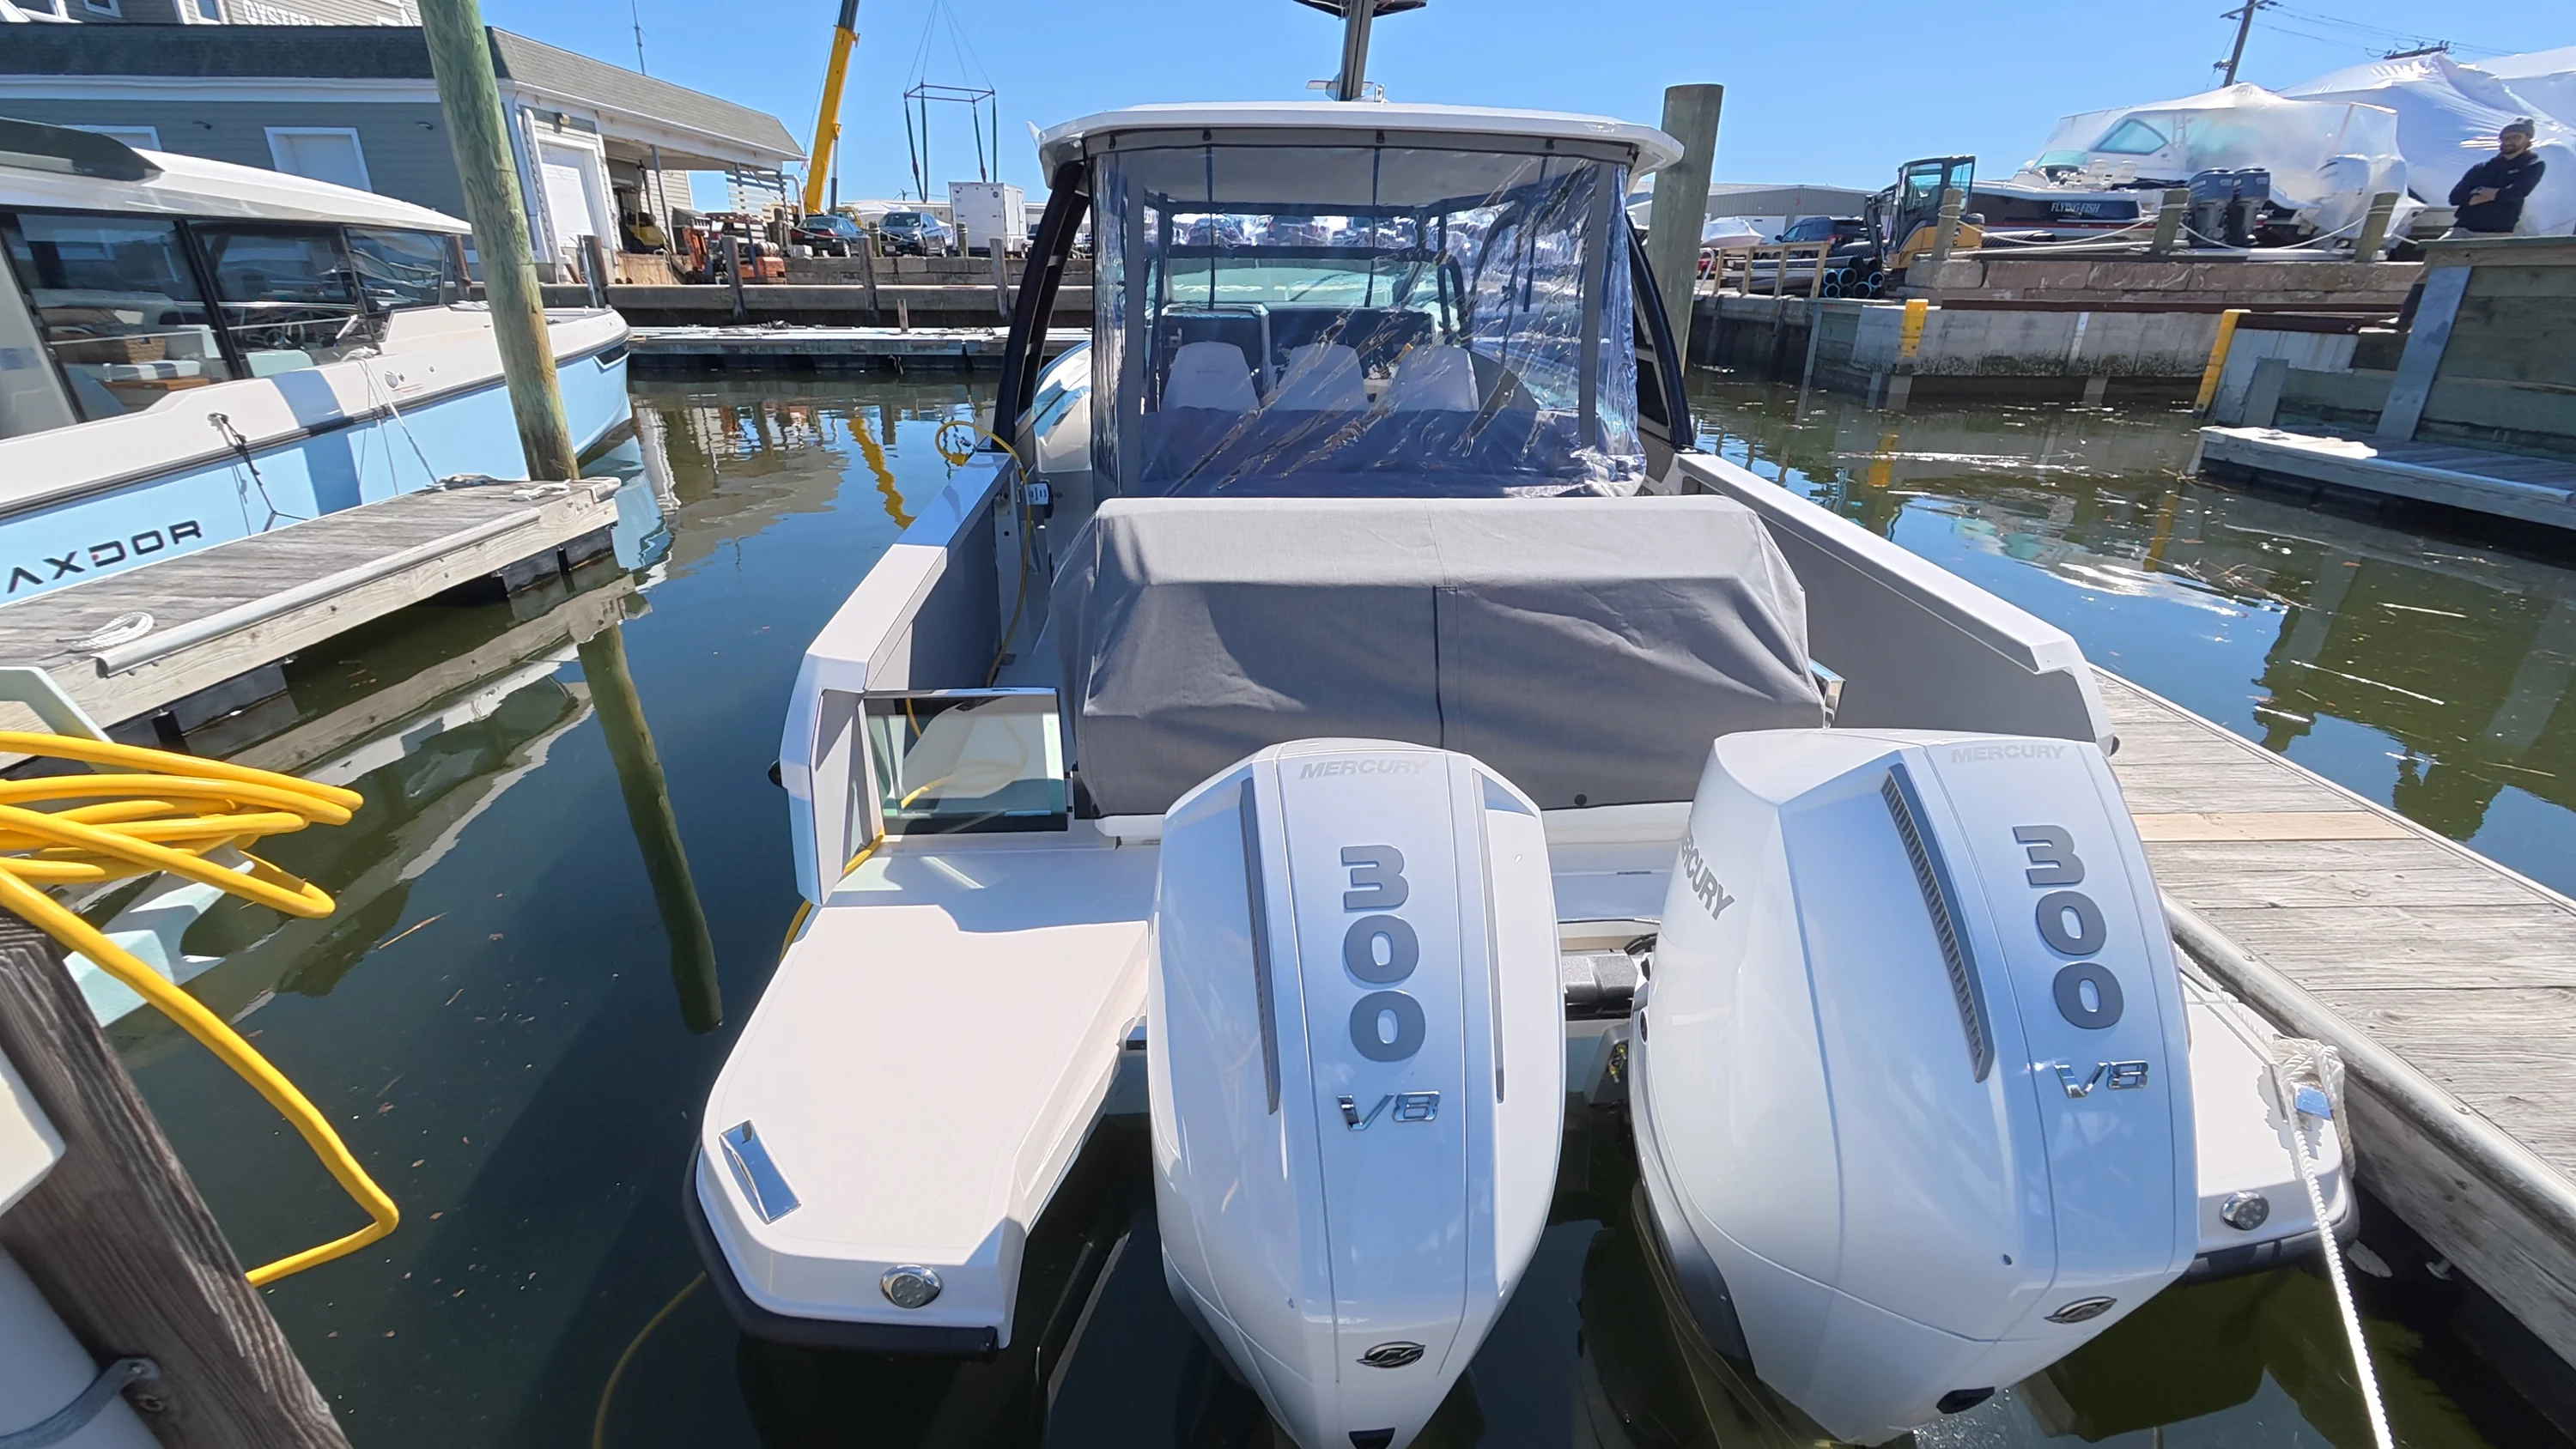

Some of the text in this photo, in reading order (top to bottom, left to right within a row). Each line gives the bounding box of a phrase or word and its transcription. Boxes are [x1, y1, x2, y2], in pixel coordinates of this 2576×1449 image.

[2050, 203, 2101, 213] FLYING FISH
[1299, 759, 1431, 779] MERCURY
[1951, 744, 2065, 764] MERCURY
[2013, 825, 2124, 1030] 300
[1340, 845, 1426, 1063] 300
[2054, 1060, 2148, 1100] V8
[1337, 1090, 1442, 1132] V8
